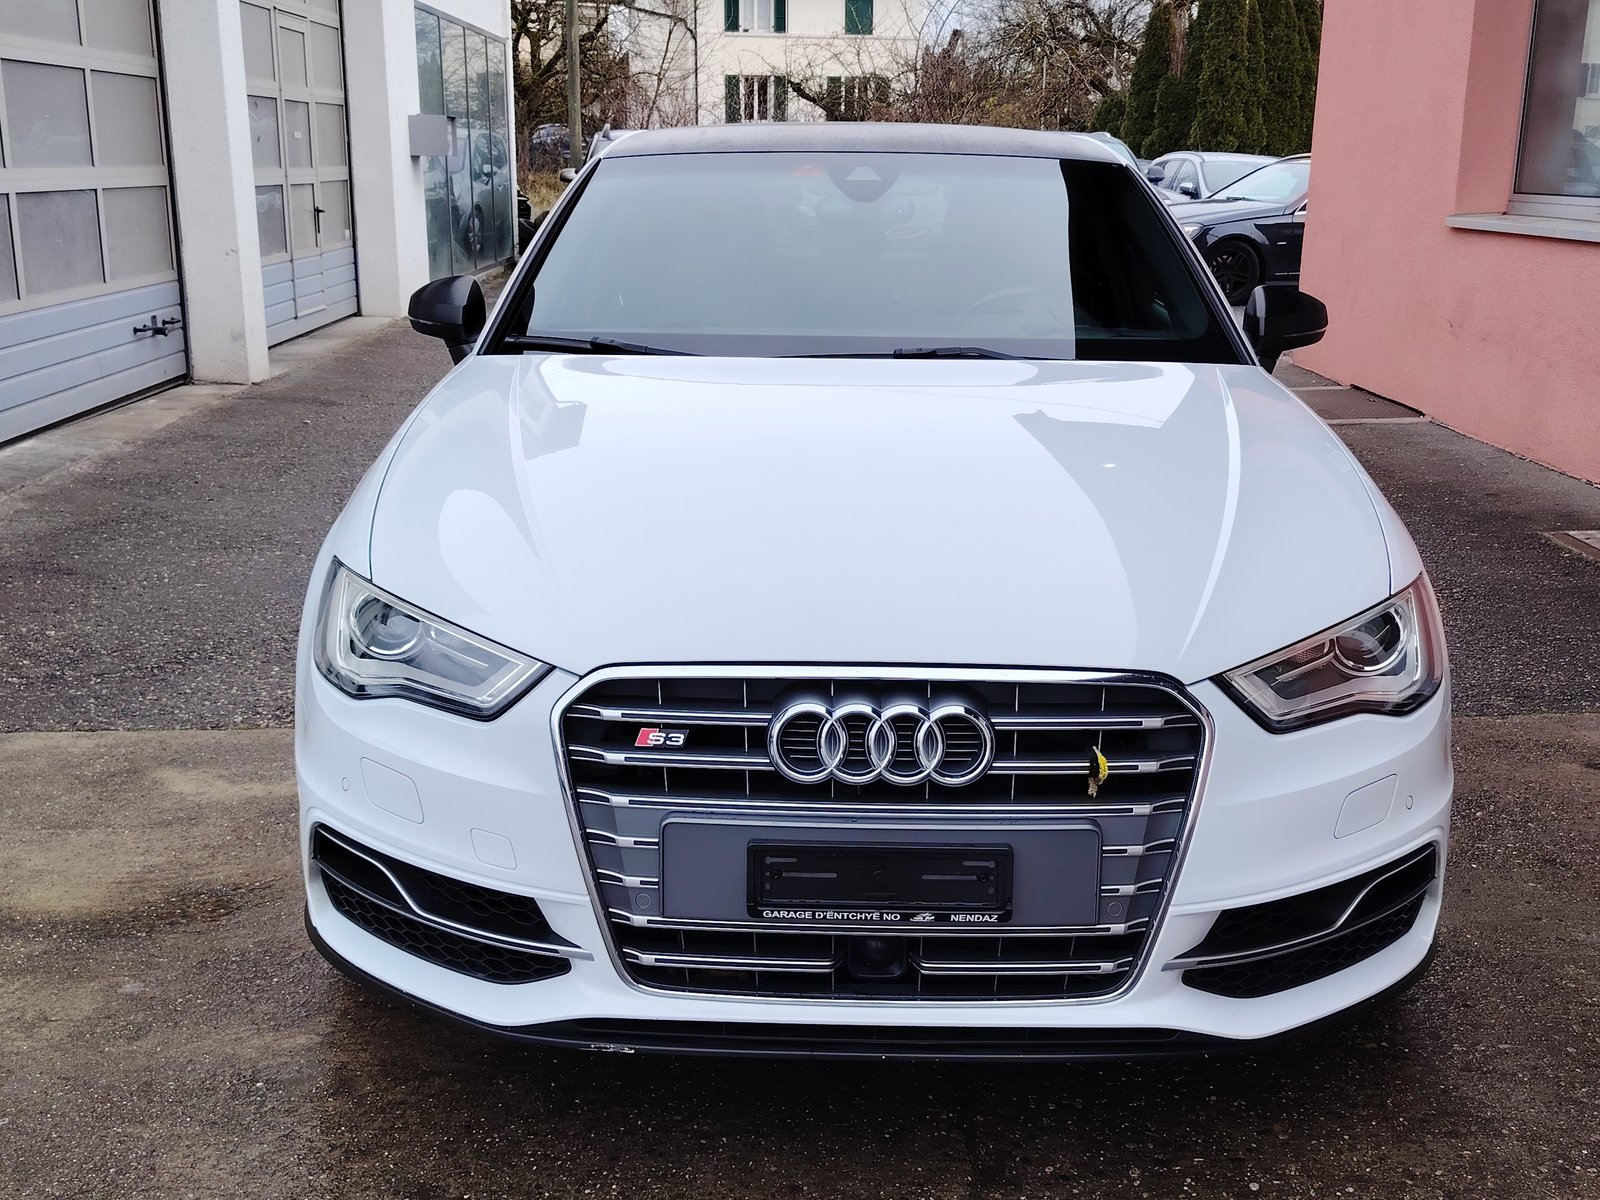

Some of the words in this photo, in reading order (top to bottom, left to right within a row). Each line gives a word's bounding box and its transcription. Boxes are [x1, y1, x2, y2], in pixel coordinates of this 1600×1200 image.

[646, 732, 685, 746] S3
[763, 910, 813, 919] GARAGE
[883, 913, 901, 921] NO
[950, 914, 999, 923] NENDAZ
